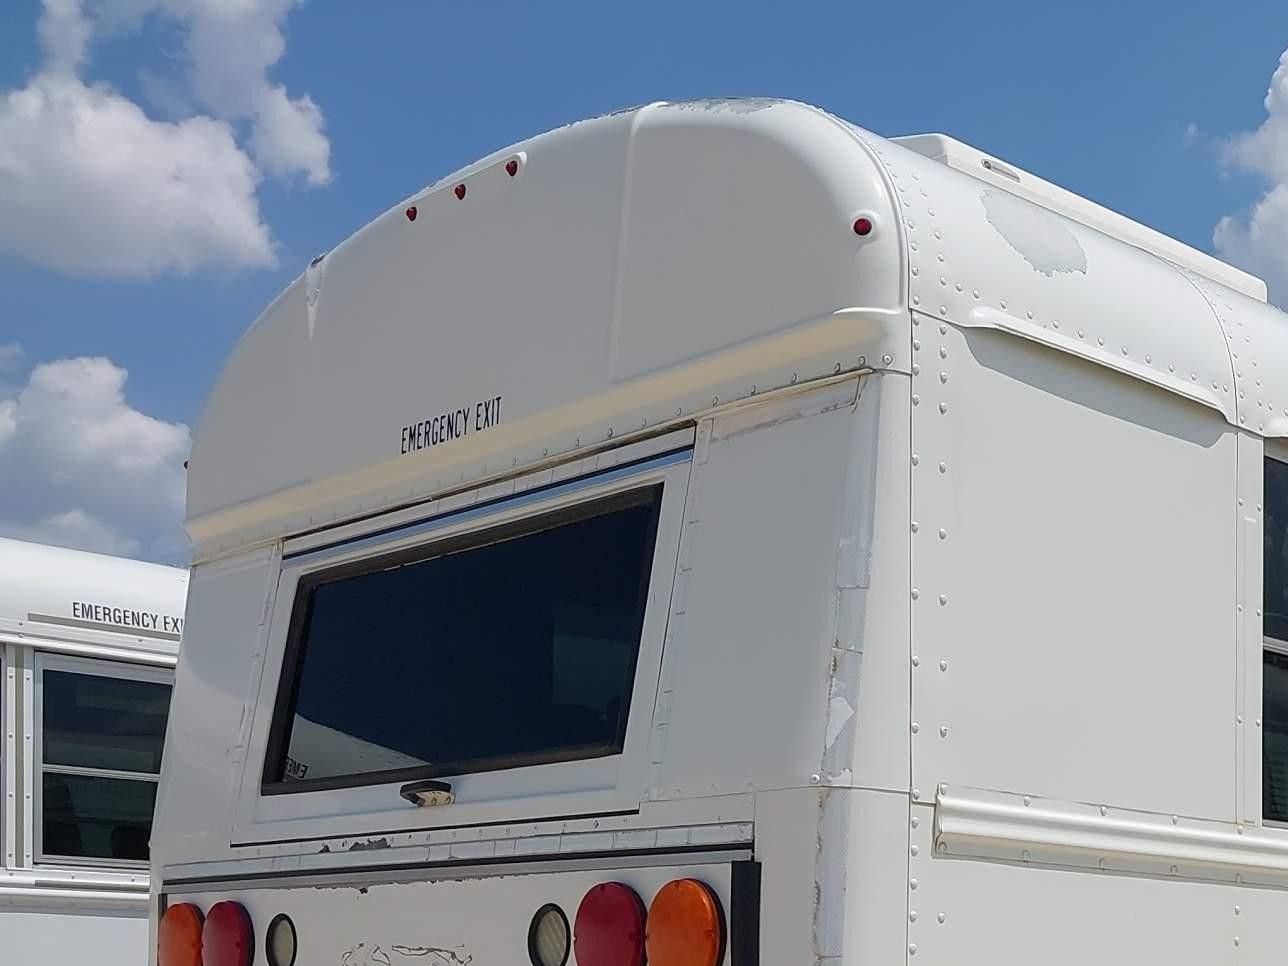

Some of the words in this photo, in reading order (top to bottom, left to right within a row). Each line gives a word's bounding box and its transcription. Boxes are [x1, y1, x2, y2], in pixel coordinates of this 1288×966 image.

[401, 407, 470, 454] EMERGENCY
[475, 396, 502, 431] EXIT
[72, 601, 158, 629] EMERGENCY
